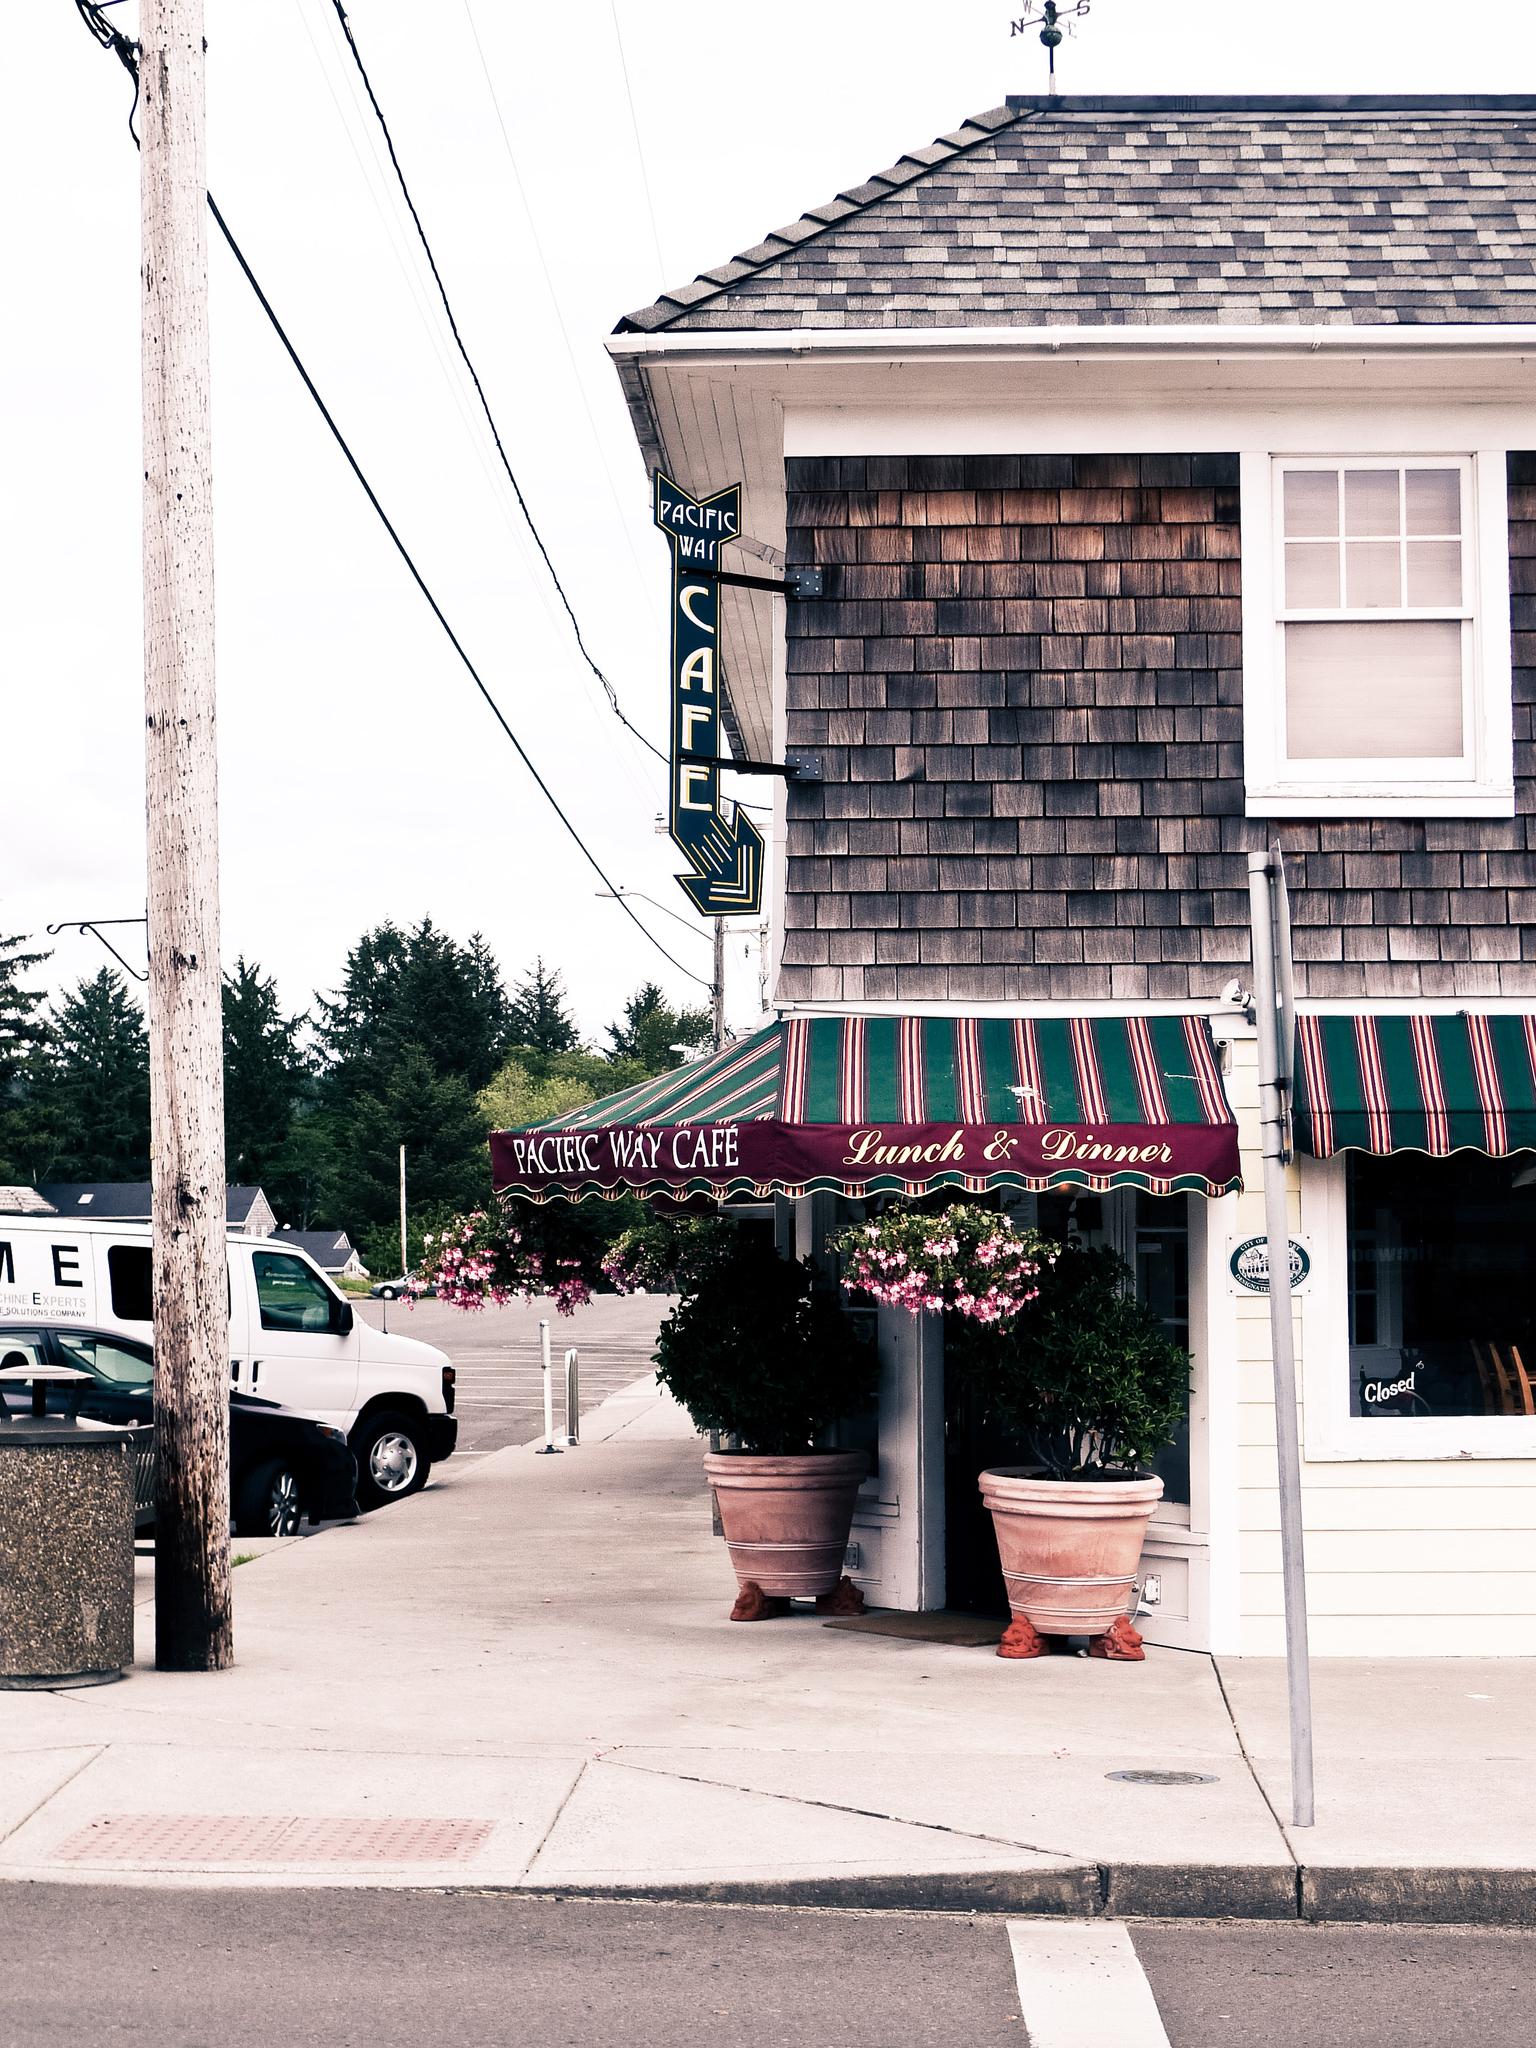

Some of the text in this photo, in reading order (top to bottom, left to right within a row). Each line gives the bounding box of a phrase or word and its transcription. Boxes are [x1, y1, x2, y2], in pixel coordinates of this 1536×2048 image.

[1077, 0, 1090, 16] S
[1010, 17, 1025, 37] N
[660, 500, 737, 533] PACIFIC
[512, 1124, 739, 1174] PACIFIC WAY CAFÉ
[842, 1129, 1173, 1166] Lunch & Dinner
[1240, 1237, 1266, 1251] CITY OF
[1235, 1273, 1270, 1292] DESIGNATE
[5, 1307, 48, 1317] SOLUTIONS
[50, 1309, 86, 1318] COMPANY
[1364, 1371, 1415, 1403] Closed
